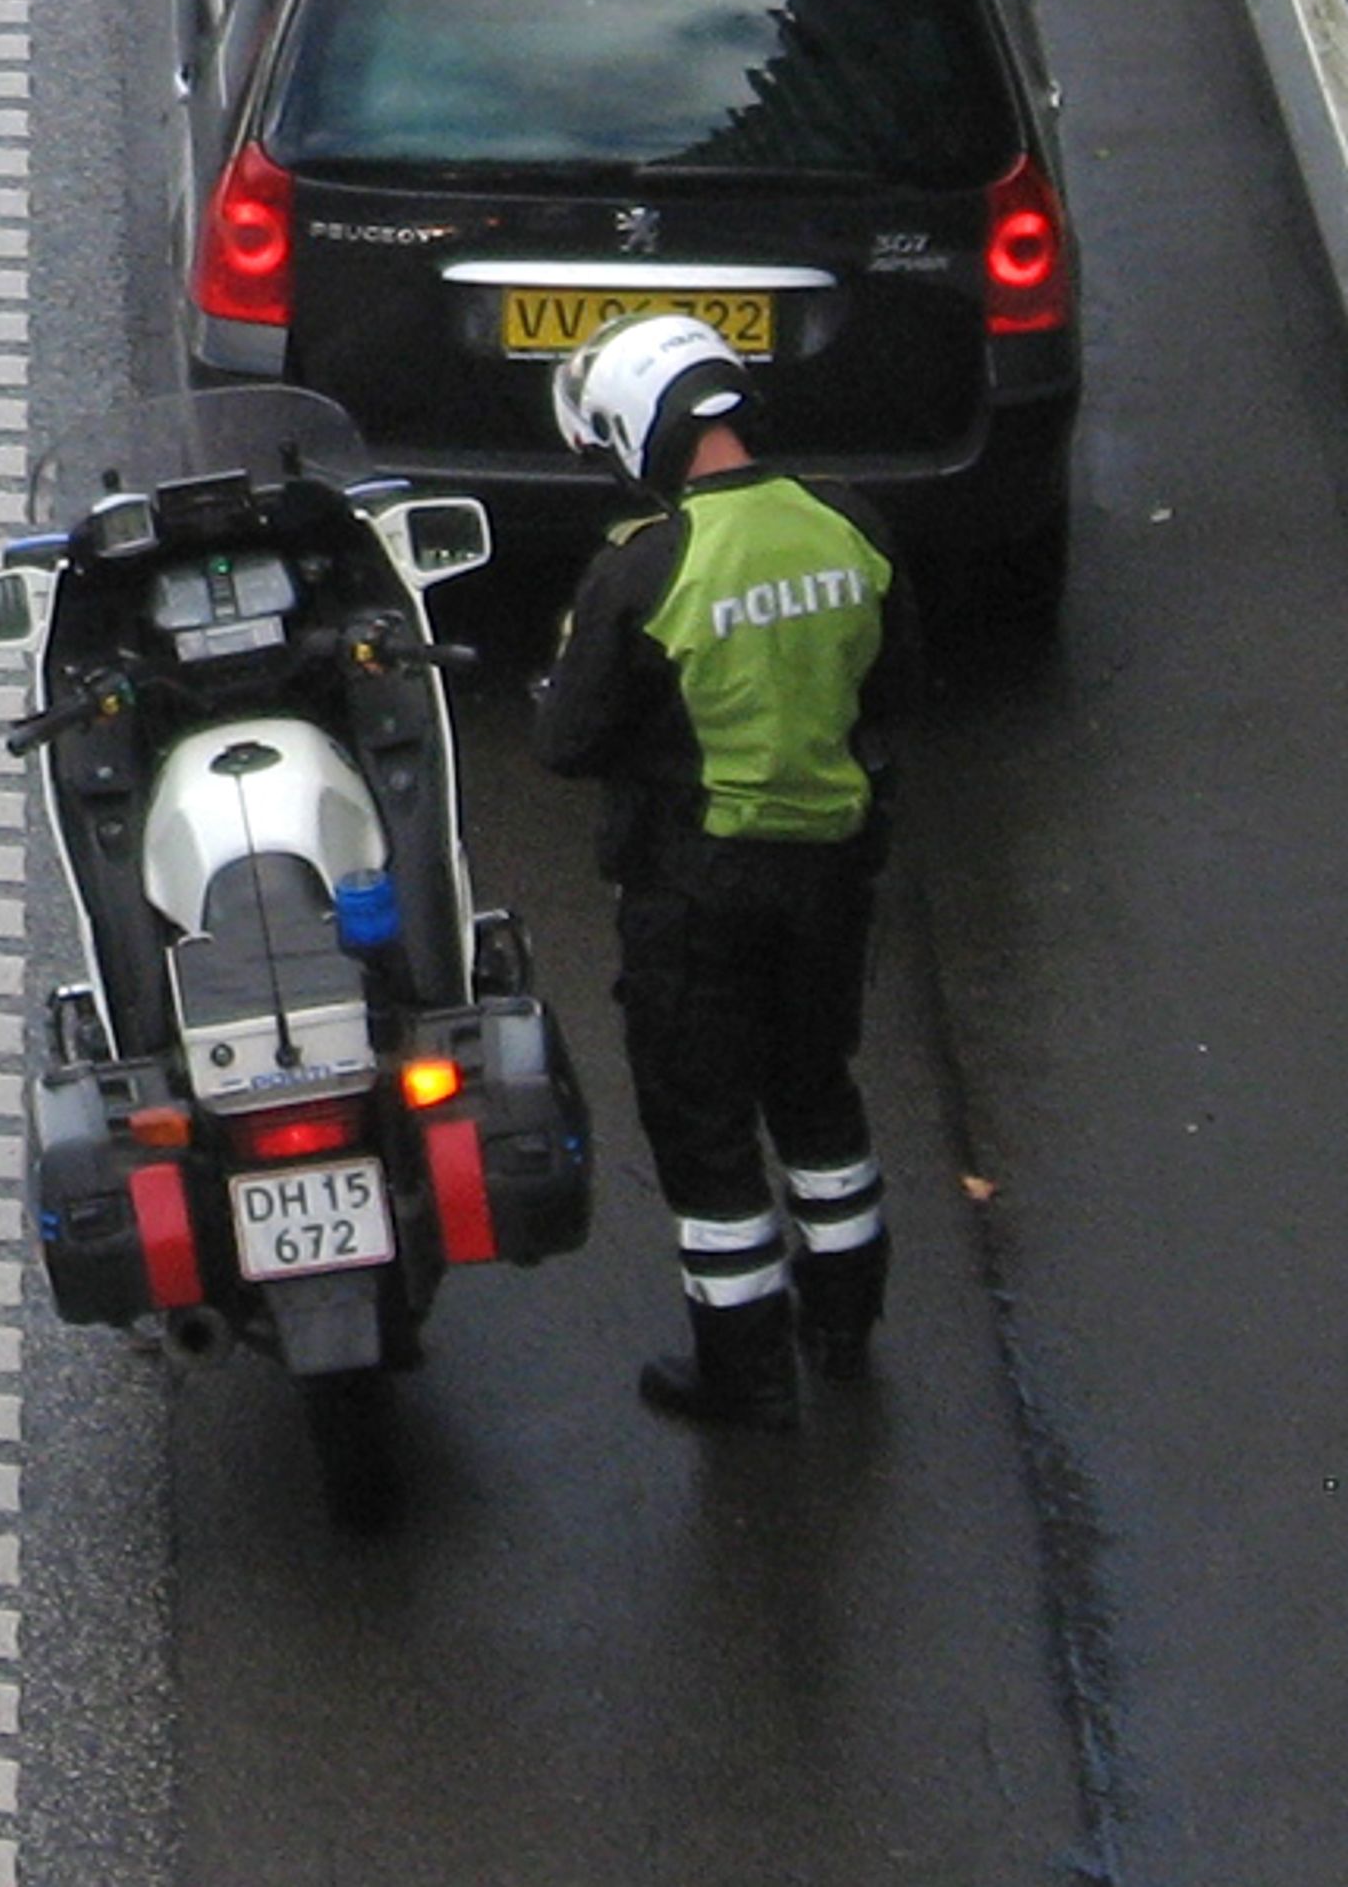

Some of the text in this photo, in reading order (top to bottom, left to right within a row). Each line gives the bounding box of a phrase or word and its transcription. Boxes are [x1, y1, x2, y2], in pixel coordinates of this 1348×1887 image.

[517, 298, 586, 339] VV
[712, 569, 863, 638] POLITI
[244, 1172, 370, 1222] DH 15
[275, 1219, 358, 1264] 672
